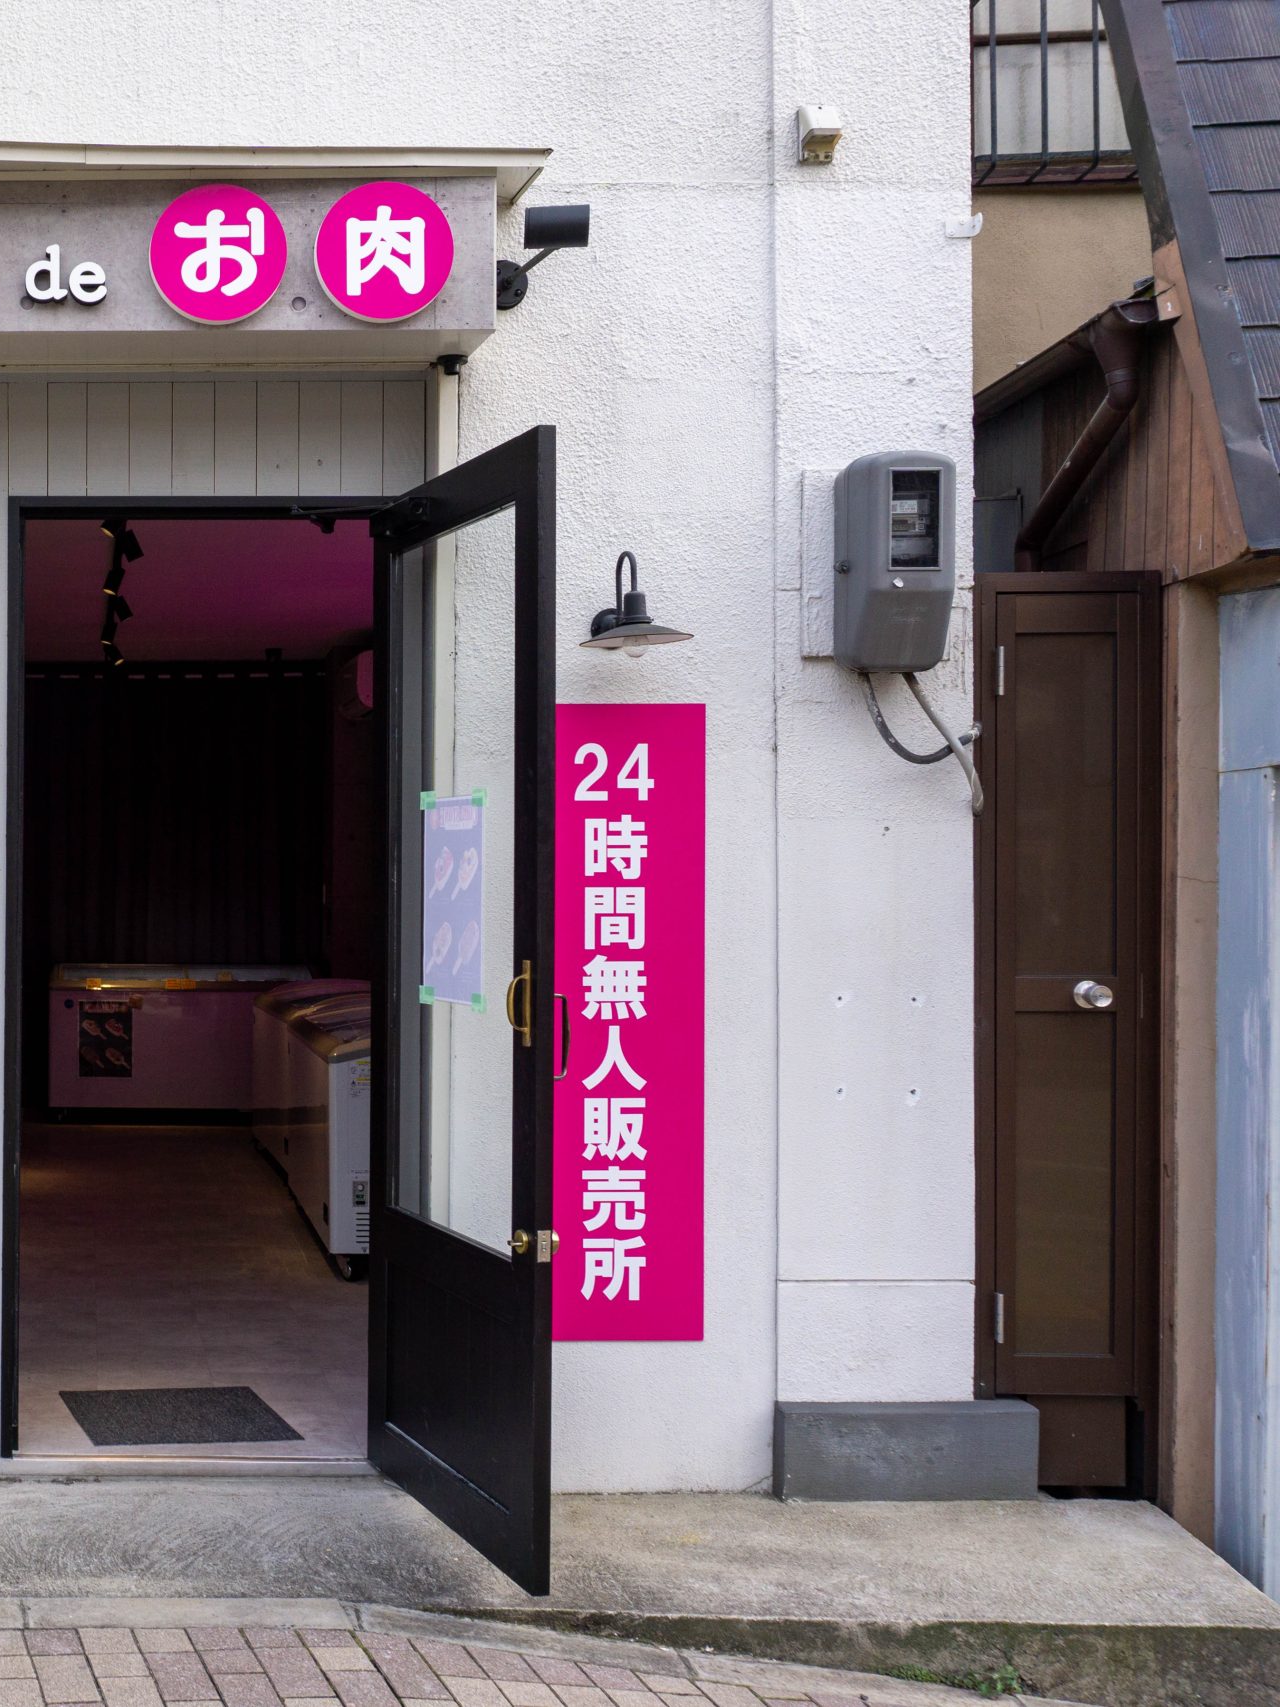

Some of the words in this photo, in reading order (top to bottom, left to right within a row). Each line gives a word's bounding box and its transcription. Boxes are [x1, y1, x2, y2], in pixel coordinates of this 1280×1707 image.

[25, 245, 108, 303] de
[173, 205, 427, 299] お肉
[573, 742, 656, 1302] 24時間無人販売所
